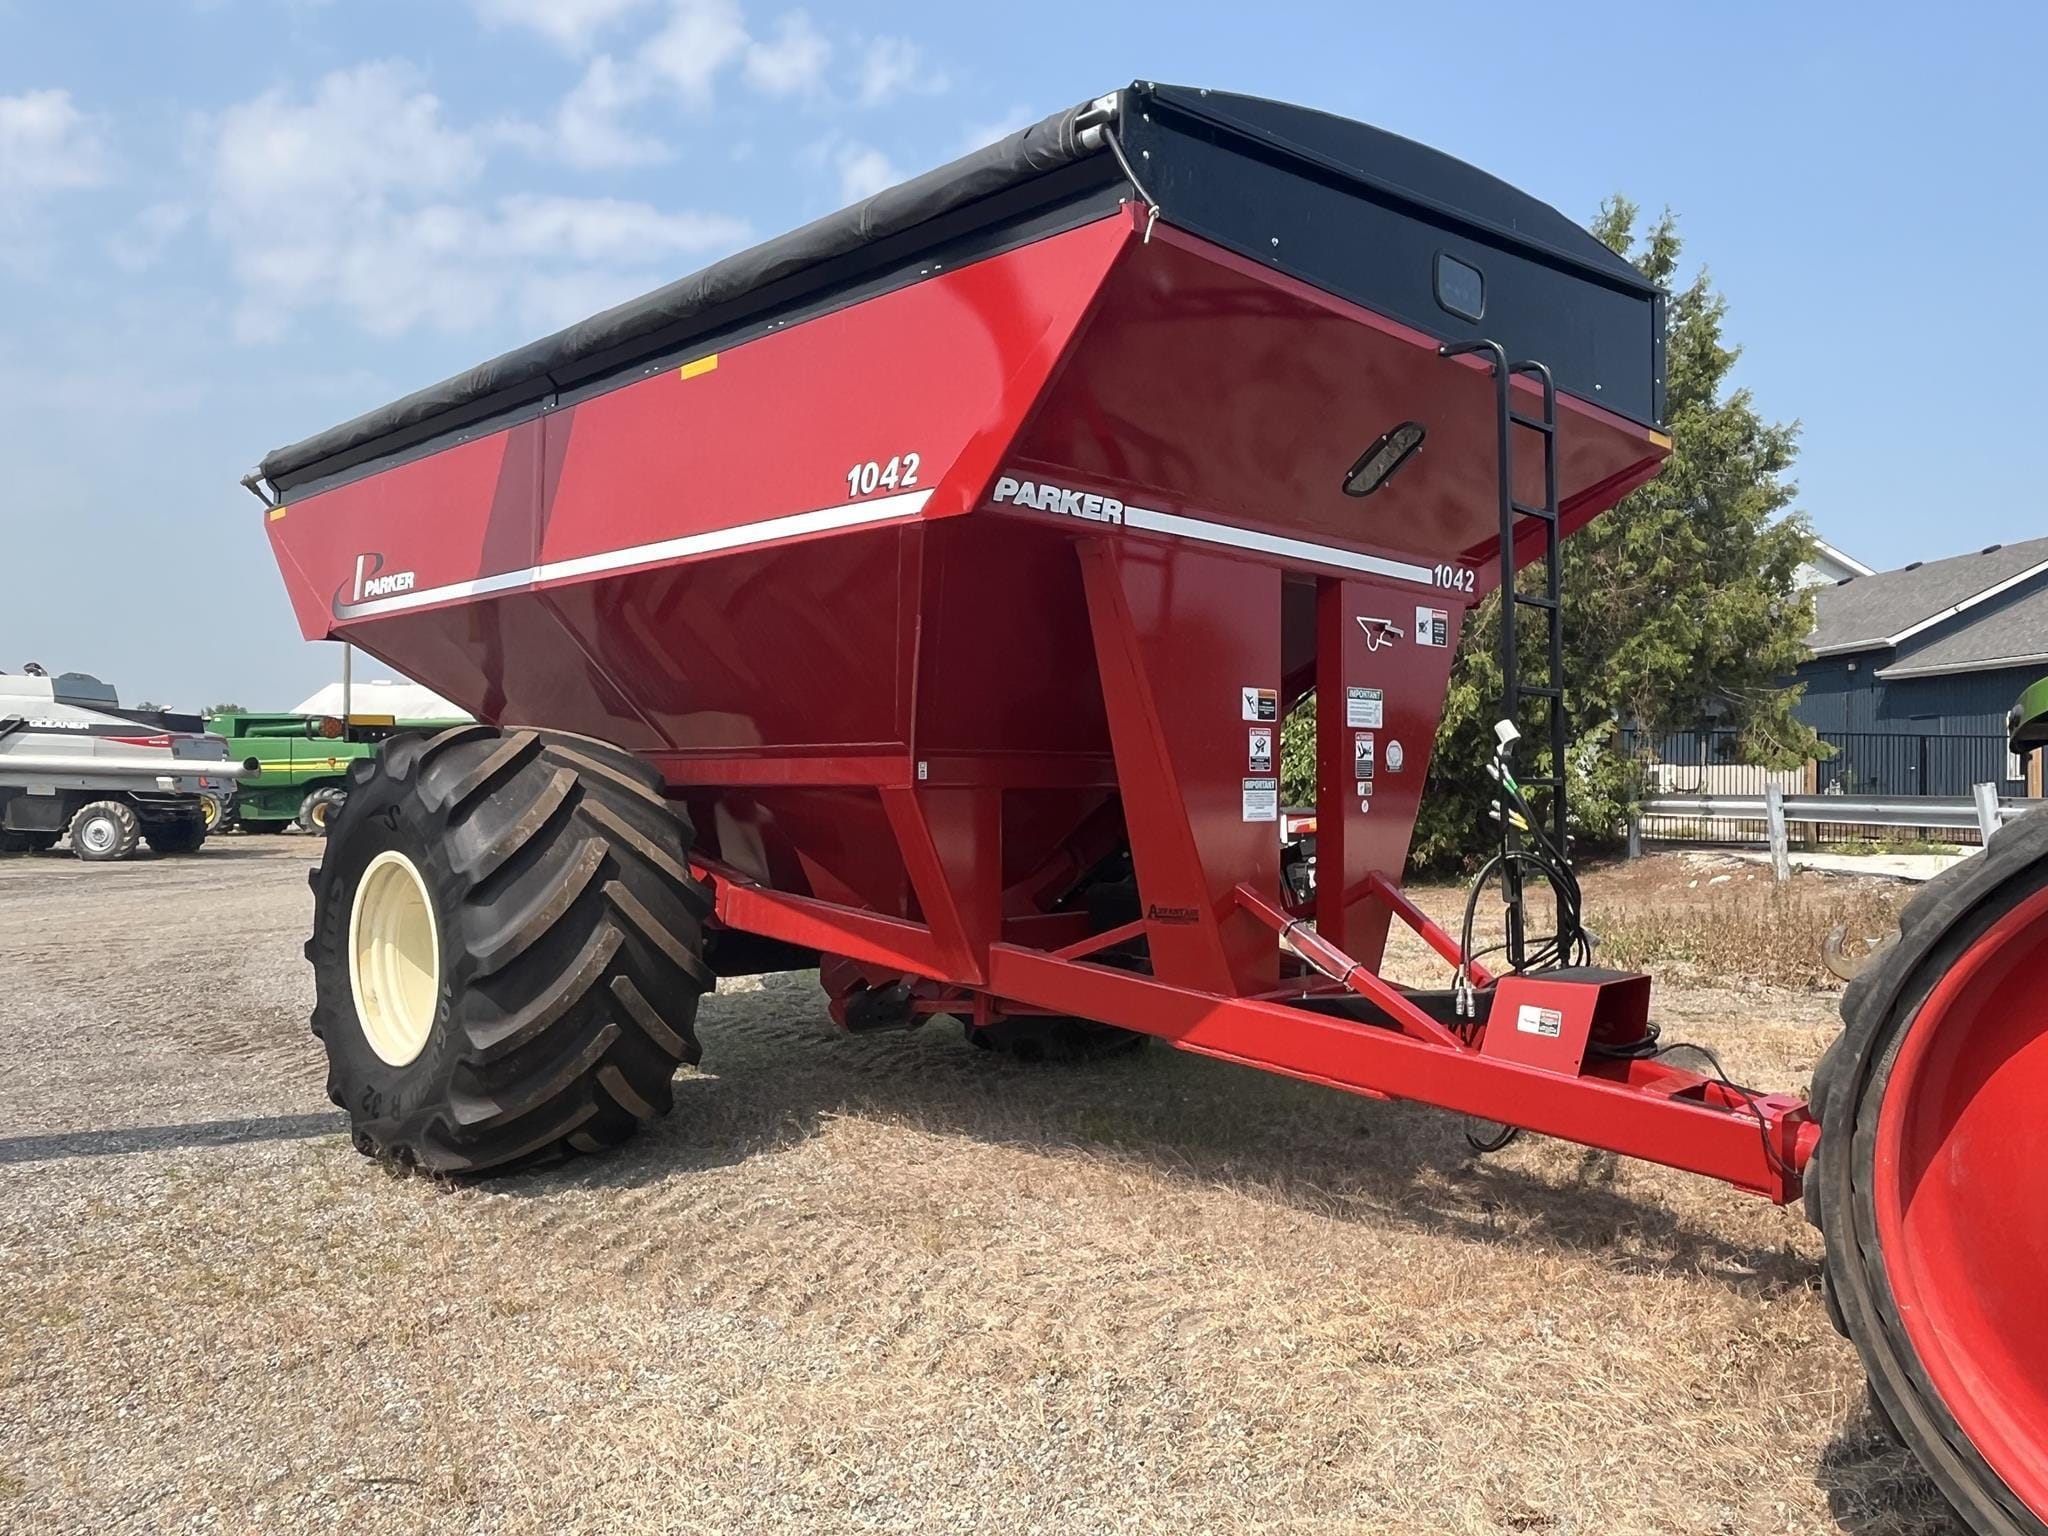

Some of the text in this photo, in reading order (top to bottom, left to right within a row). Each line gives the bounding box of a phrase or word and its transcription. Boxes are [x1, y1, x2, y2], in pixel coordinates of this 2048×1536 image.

[846, 452, 920, 498] 1042
[992, 476, 1124, 525] PARKER
[364, 570, 415, 598] PARKER
[1434, 564, 1475, 593] 1042
[29, 719, 89, 730] GLEANER
